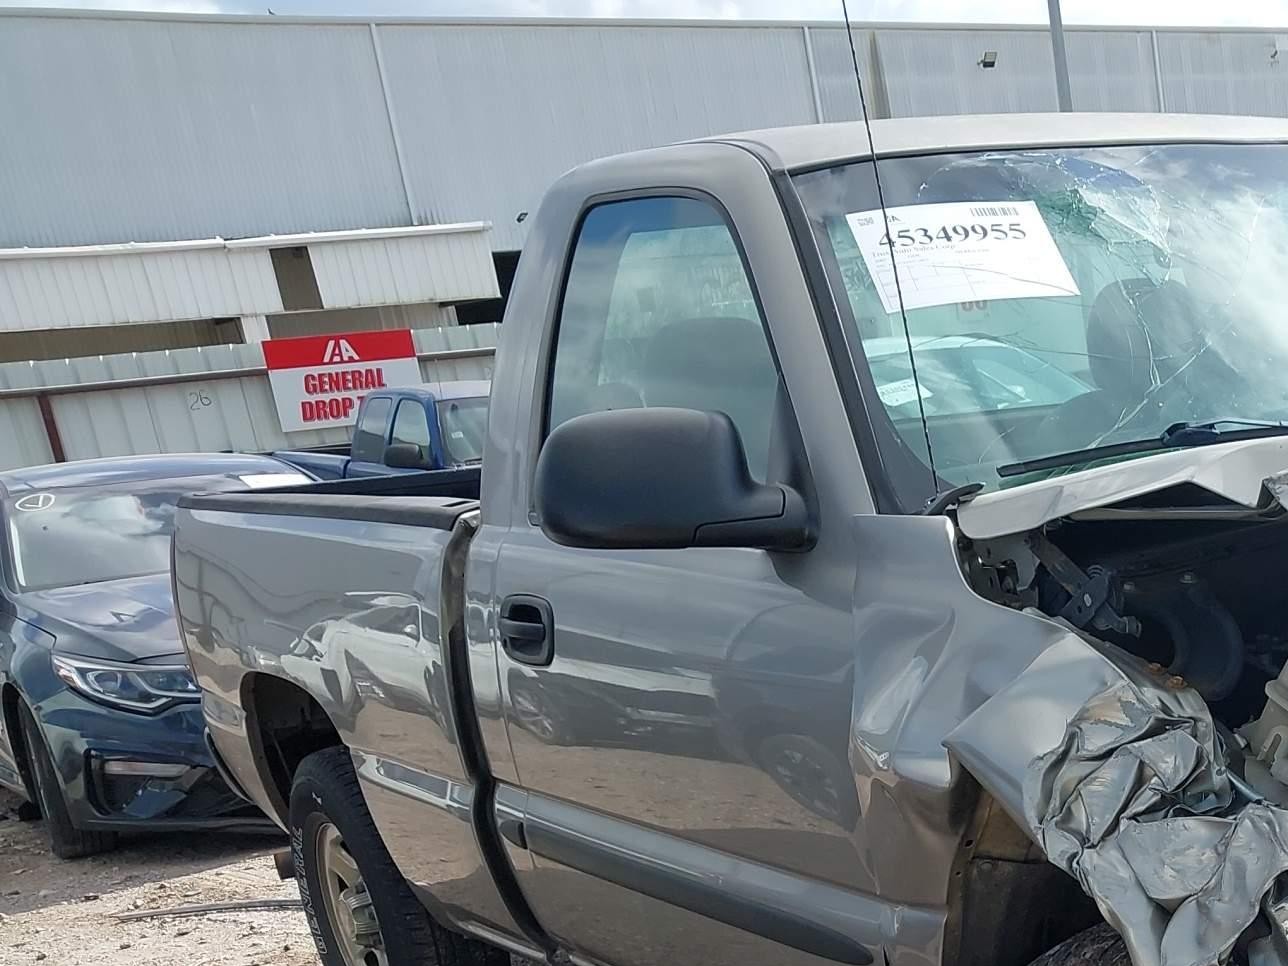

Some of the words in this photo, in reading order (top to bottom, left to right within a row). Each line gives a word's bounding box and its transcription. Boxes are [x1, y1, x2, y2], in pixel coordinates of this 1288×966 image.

[879, 223, 1027, 248] 45349955
[303, 367, 387, 397] GENERAL
[301, 396, 355, 424] DROP
